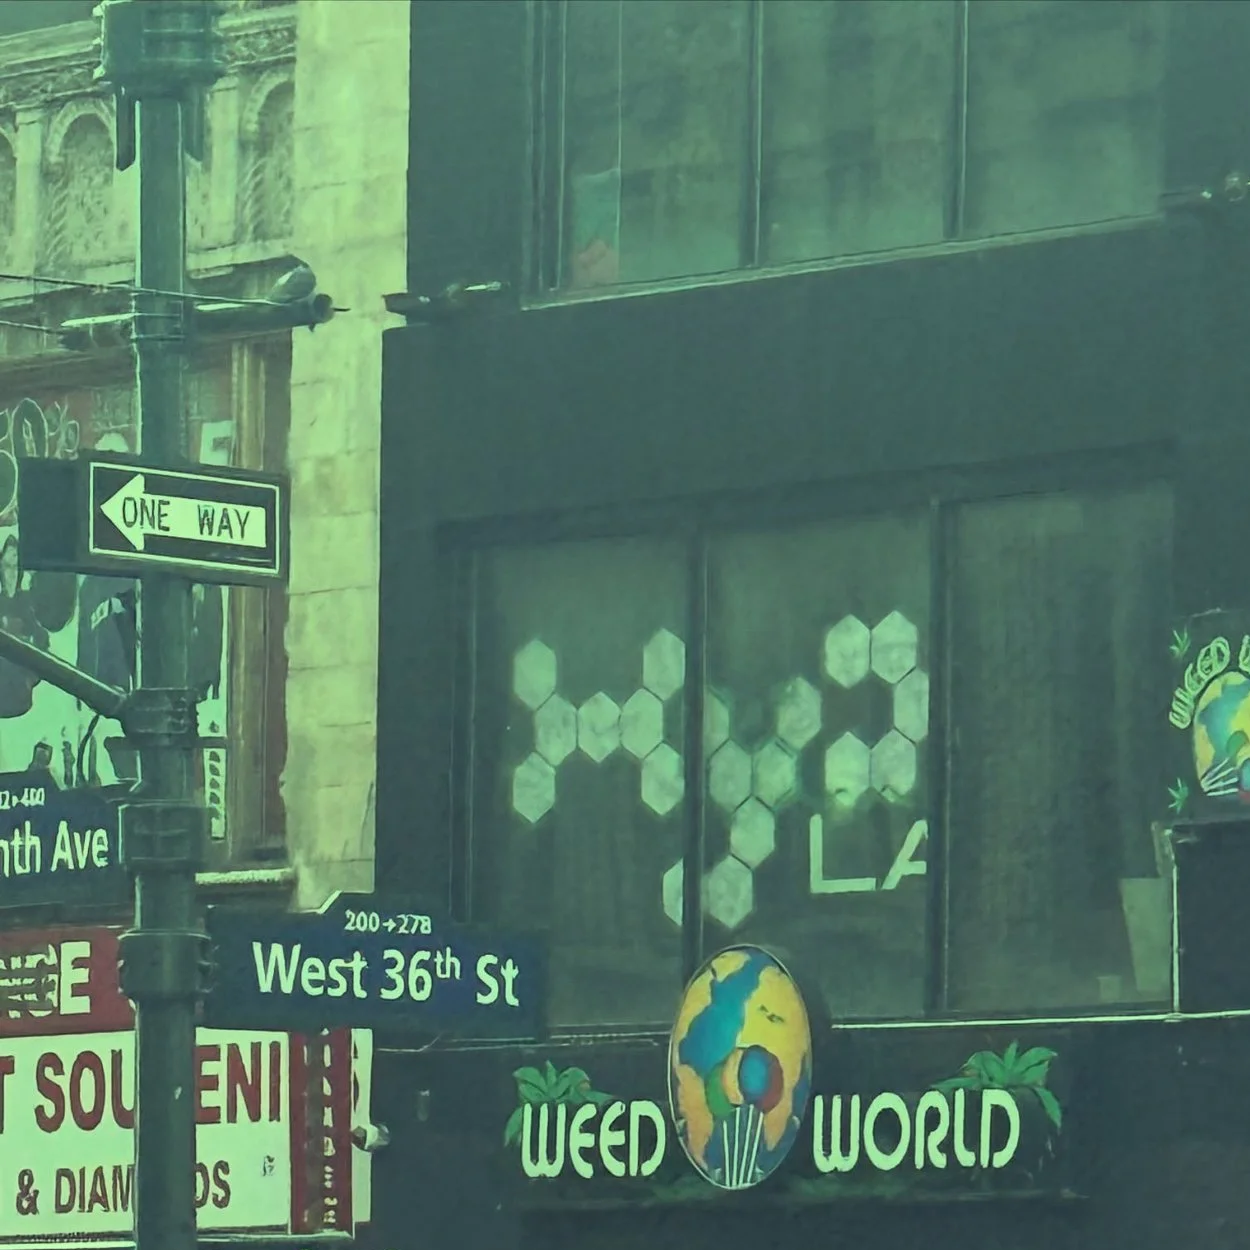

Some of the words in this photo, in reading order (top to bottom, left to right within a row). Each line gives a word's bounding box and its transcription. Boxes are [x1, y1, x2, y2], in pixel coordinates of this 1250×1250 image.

[122, 496, 171, 532] ONE
[197, 504, 251, 541] WAY
[50, 820, 109, 872] Ave
[344, 909, 380, 932] 200
[252, 941, 369, 999] West
[379, 946, 462, 1001] 36th
[475, 954, 520, 1007] St
[521, 1101, 667, 1179] WEED
[812, 1087, 1021, 1173] WORLD
[16, 1168, 40, 1216] &
[54, 1160, 231, 1213] DIAMDS
